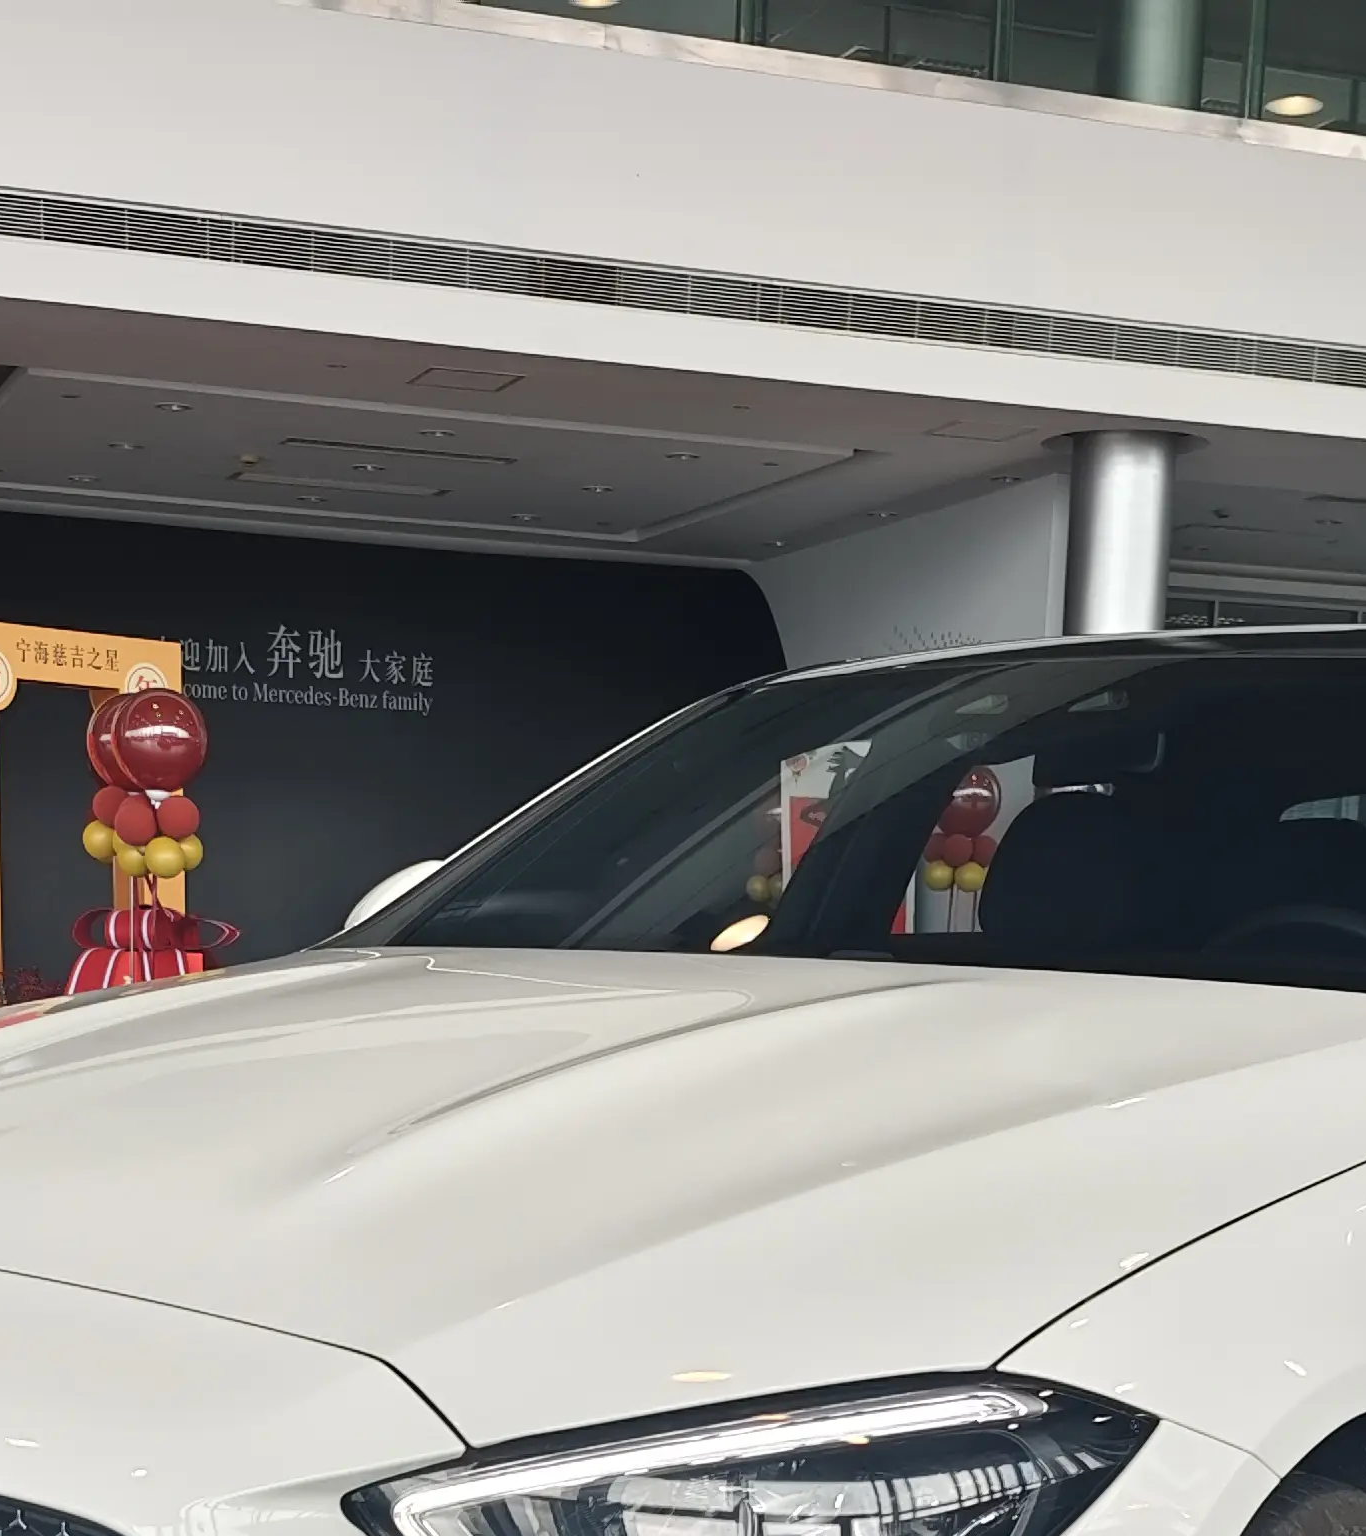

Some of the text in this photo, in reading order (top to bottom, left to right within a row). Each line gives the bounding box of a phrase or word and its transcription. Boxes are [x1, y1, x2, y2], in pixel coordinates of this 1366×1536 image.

[16, 638, 120, 672] 宁海慈吉之星
[181, 624, 435, 688] 迎加入 奔驰 大家庭
[183, 682, 227, 700] come
[231, 683, 248, 702] to
[252, 682, 379, 710] Mercedes-Benz
[382, 690, 434, 717] family
